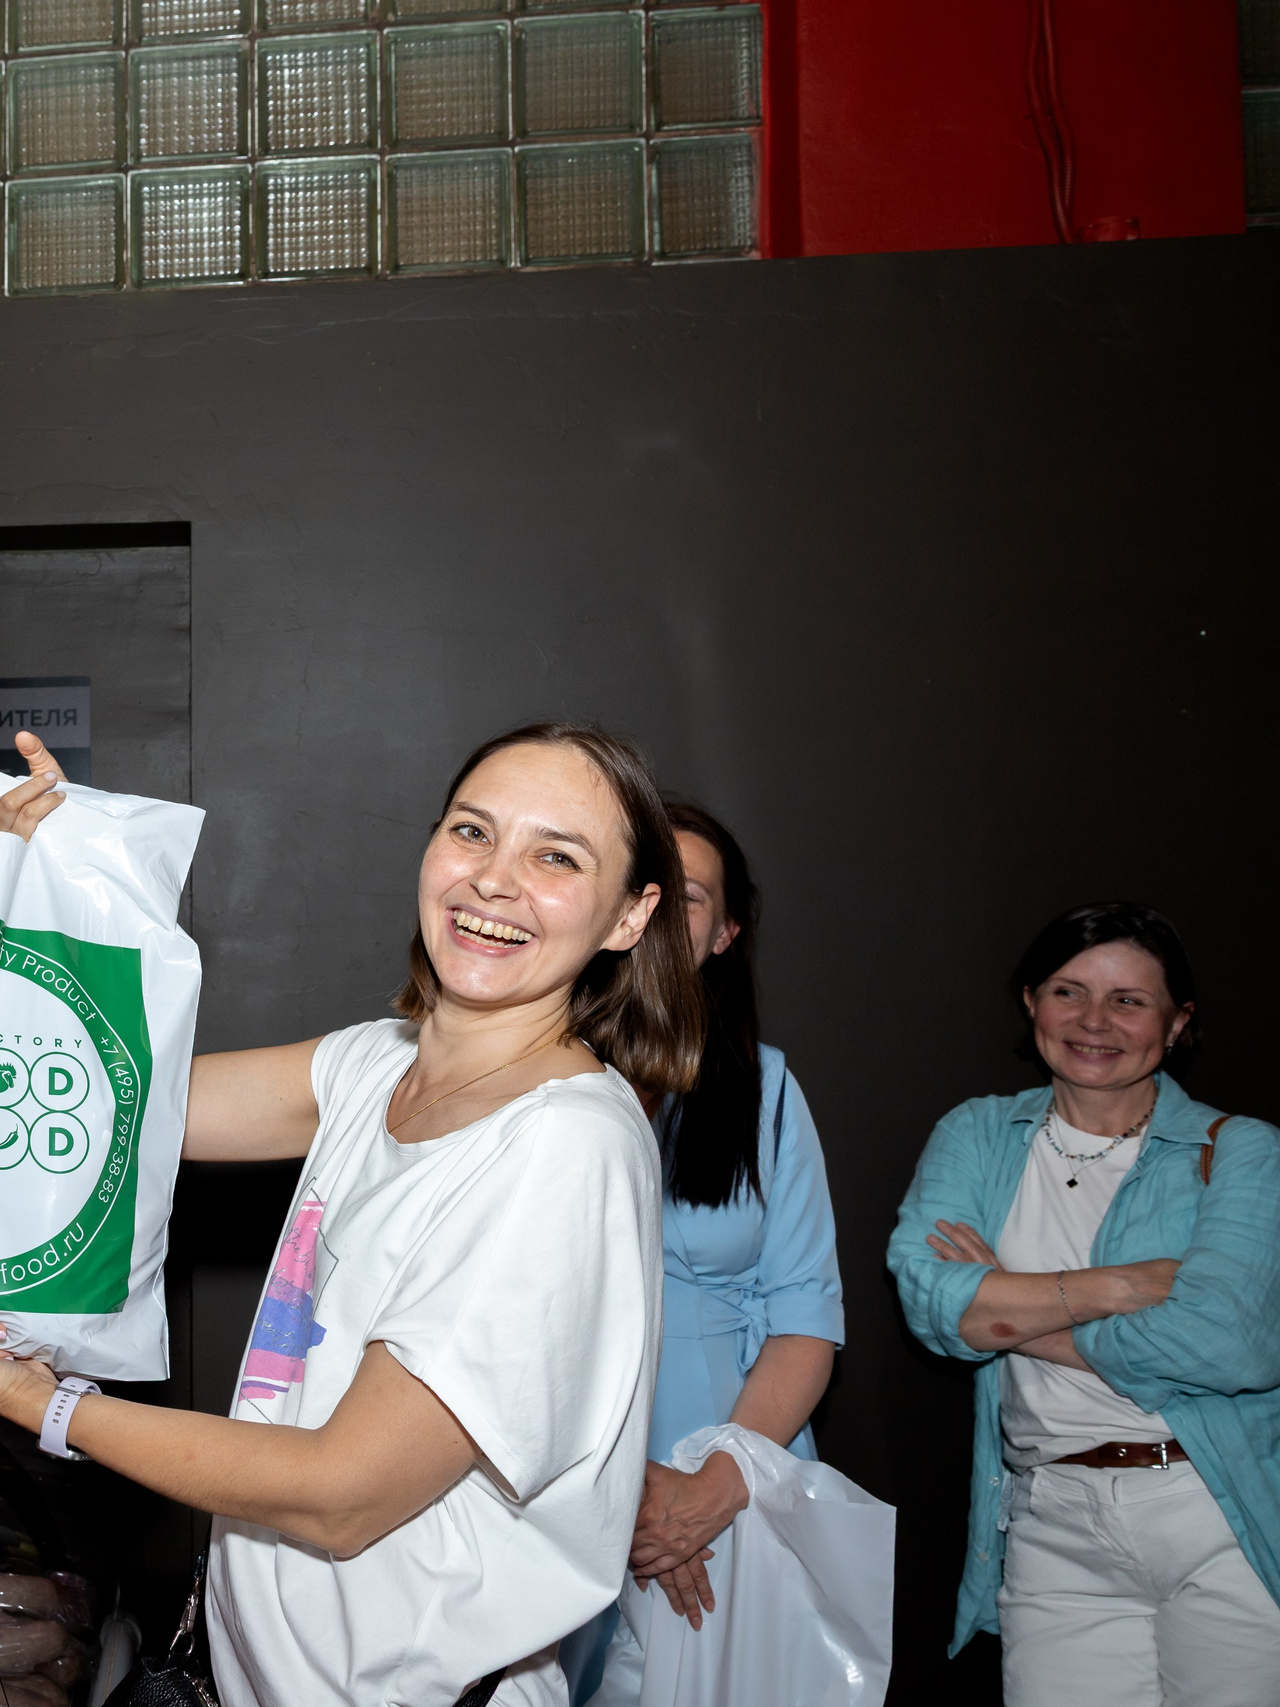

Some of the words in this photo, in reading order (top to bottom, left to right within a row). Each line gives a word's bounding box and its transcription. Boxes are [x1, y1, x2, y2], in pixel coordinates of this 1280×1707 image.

[21, 954, 97, 1022] Product
[100, 1035, 120, 1055] +7
[108, 1060, 134, 1106] (495)
[98, 1113, 132, 1204] 799-38-83
